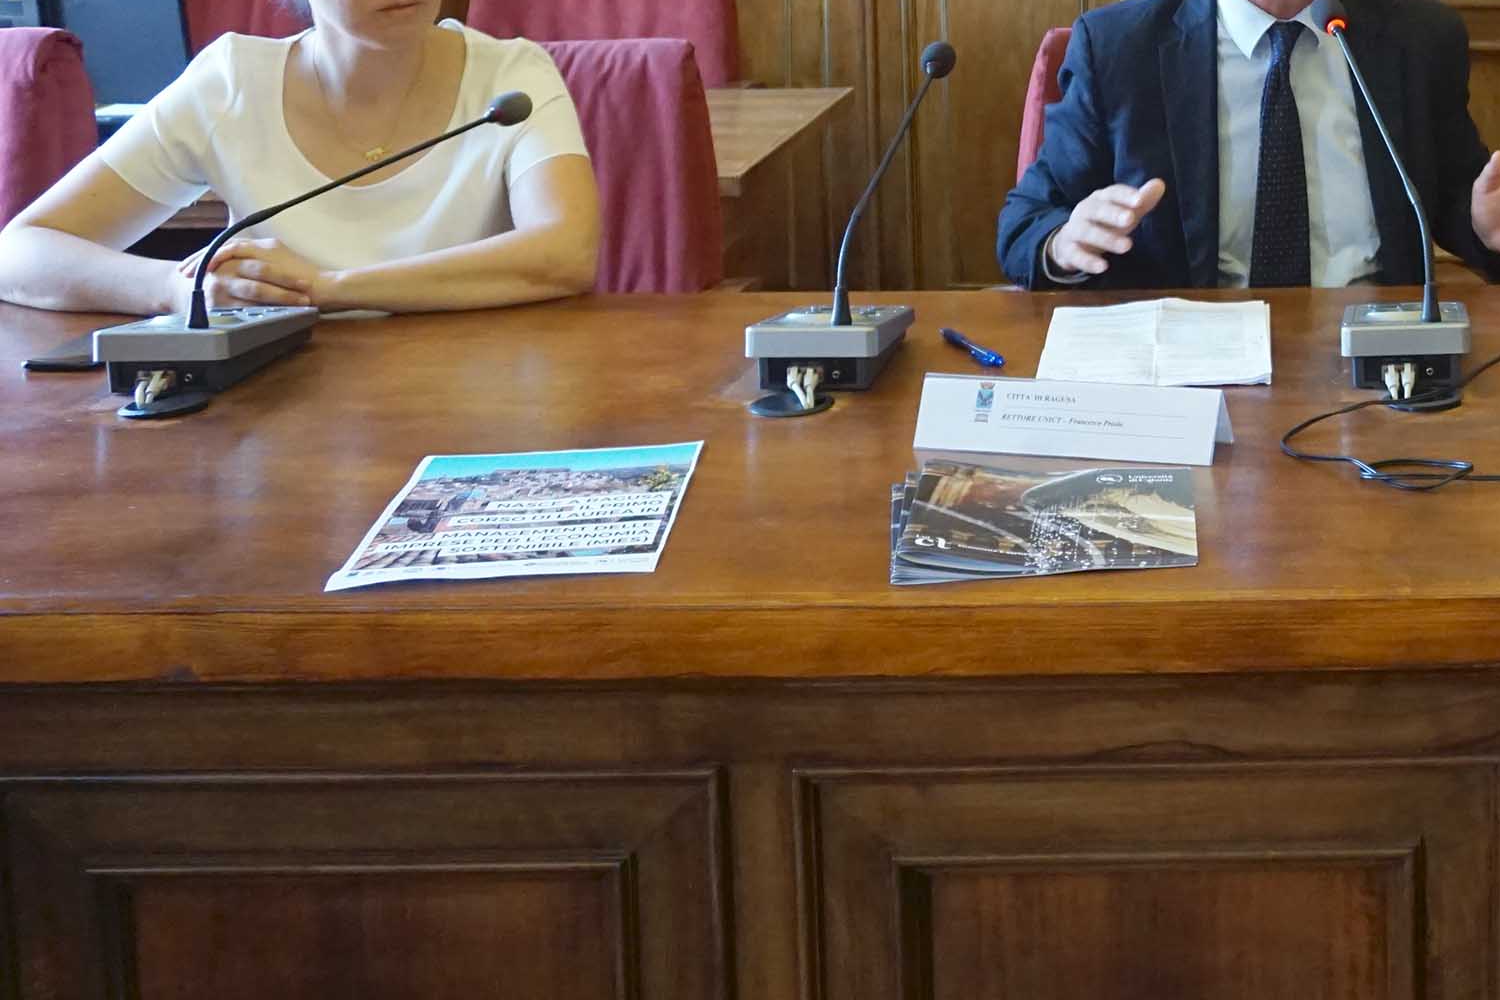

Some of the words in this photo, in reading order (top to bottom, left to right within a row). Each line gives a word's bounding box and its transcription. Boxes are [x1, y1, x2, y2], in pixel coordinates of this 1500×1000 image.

[1002, 413, 1037, 423] RETTORE
[496, 499, 557, 510] NASCE
[597, 499, 664, 509] PRIMO
[456, 514, 527, 525] CORSO
[531, 513, 553, 521] DI
[554, 509, 636, 520] LAUREA
[640, 506, 660, 514] IN
[442, 525, 583, 539] MANAGEMENT
[384, 540, 477, 551] IMPRESE
[482, 536, 522, 545] PER
[449, 540, 577, 553] SOSTENIBILE
